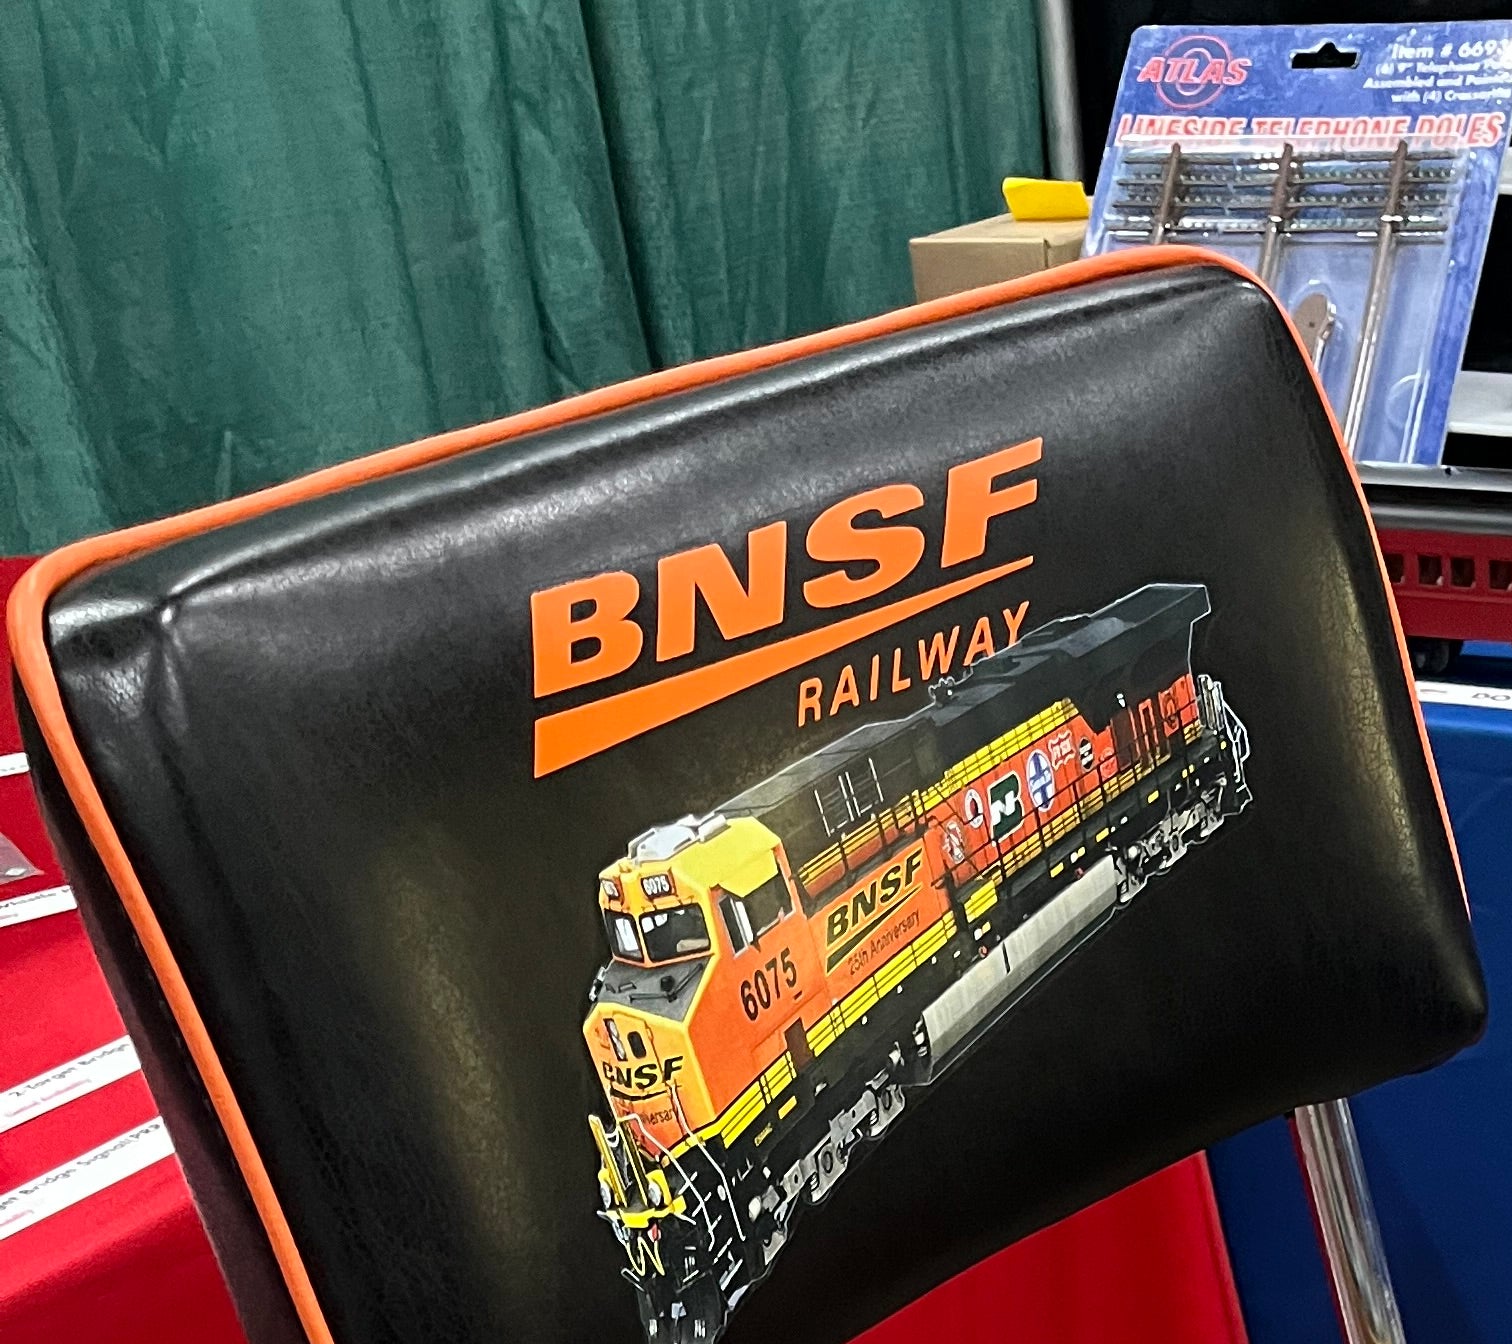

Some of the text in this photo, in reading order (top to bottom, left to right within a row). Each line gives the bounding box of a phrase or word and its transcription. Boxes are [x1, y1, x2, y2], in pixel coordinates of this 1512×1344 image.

[1391, 42, 1434, 59] Item
[1440, 43, 1453, 58] #
[1136, 56, 1253, 85] ATLAS
[1363, 75, 1435, 88] Assembled
[1436, 75, 1464, 87] and
[1114, 112, 1506, 151] LINESIDE TELEPHONE POLES
[530, 436, 1043, 699] BNSF
[798, 600, 1030, 728] RAILWAY
[1472, 692, 1511, 702] DO
[826, 847, 923, 948] BNSF
[740, 947, 797, 1022] 6075
